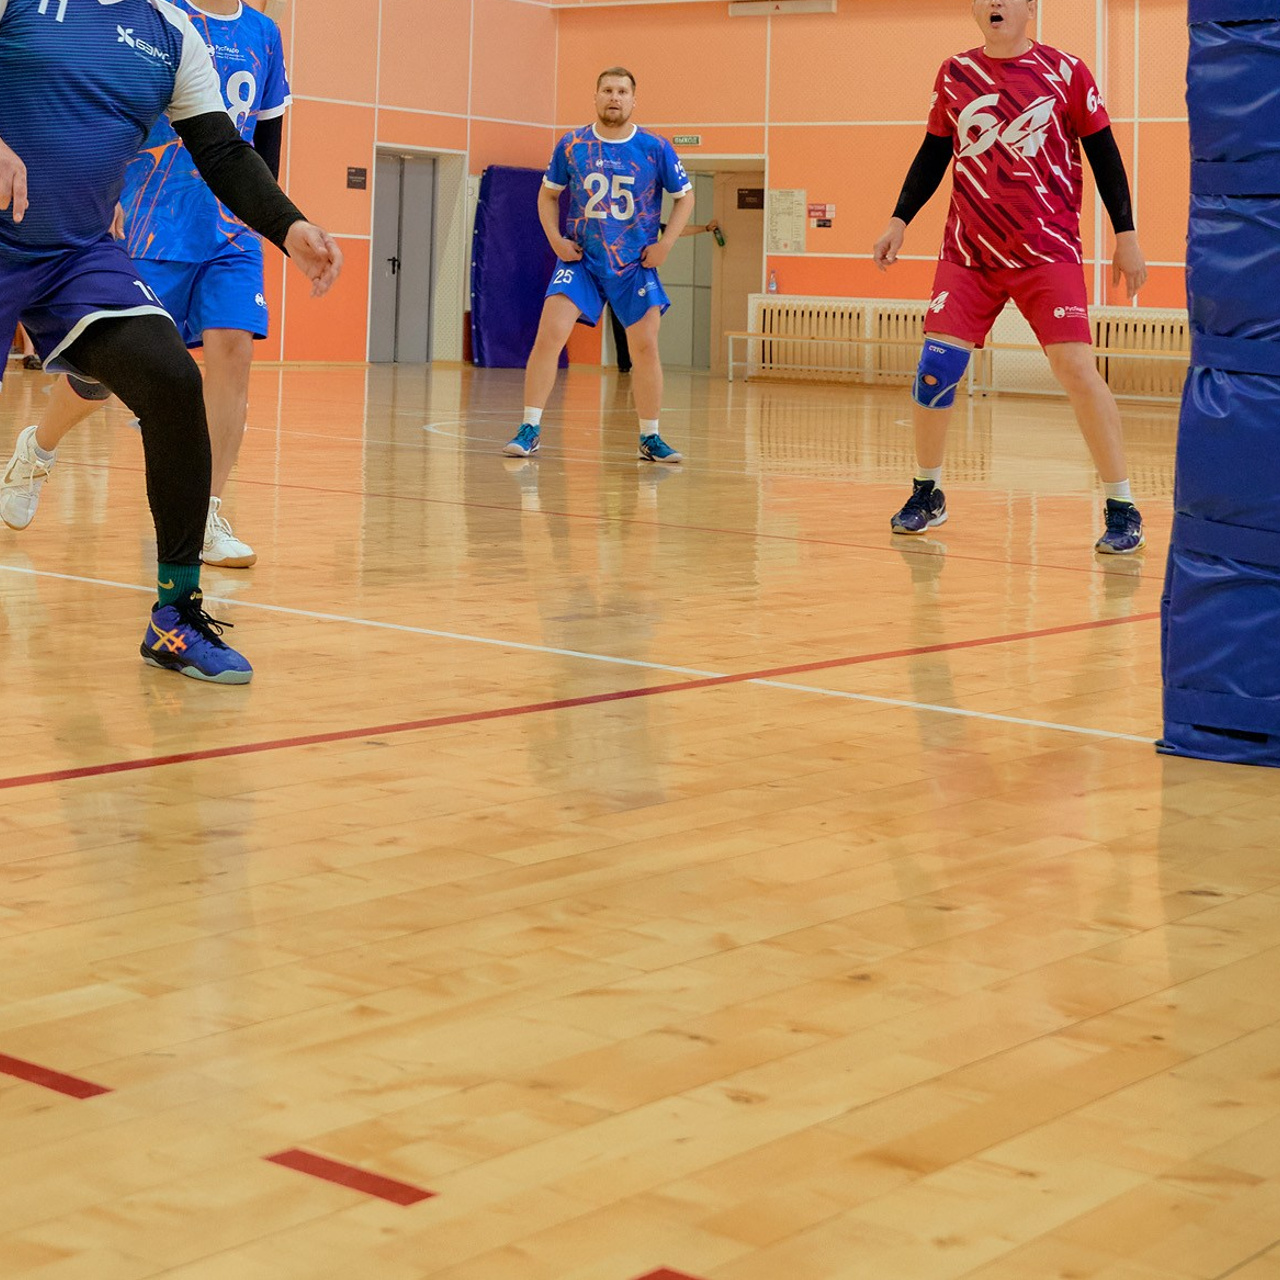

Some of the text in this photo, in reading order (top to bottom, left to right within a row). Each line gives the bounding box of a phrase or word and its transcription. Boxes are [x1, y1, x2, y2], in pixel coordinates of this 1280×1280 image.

[958, 93, 1057, 159] 64
[584, 172, 635, 220] 25
[553, 269, 574, 284] 25
